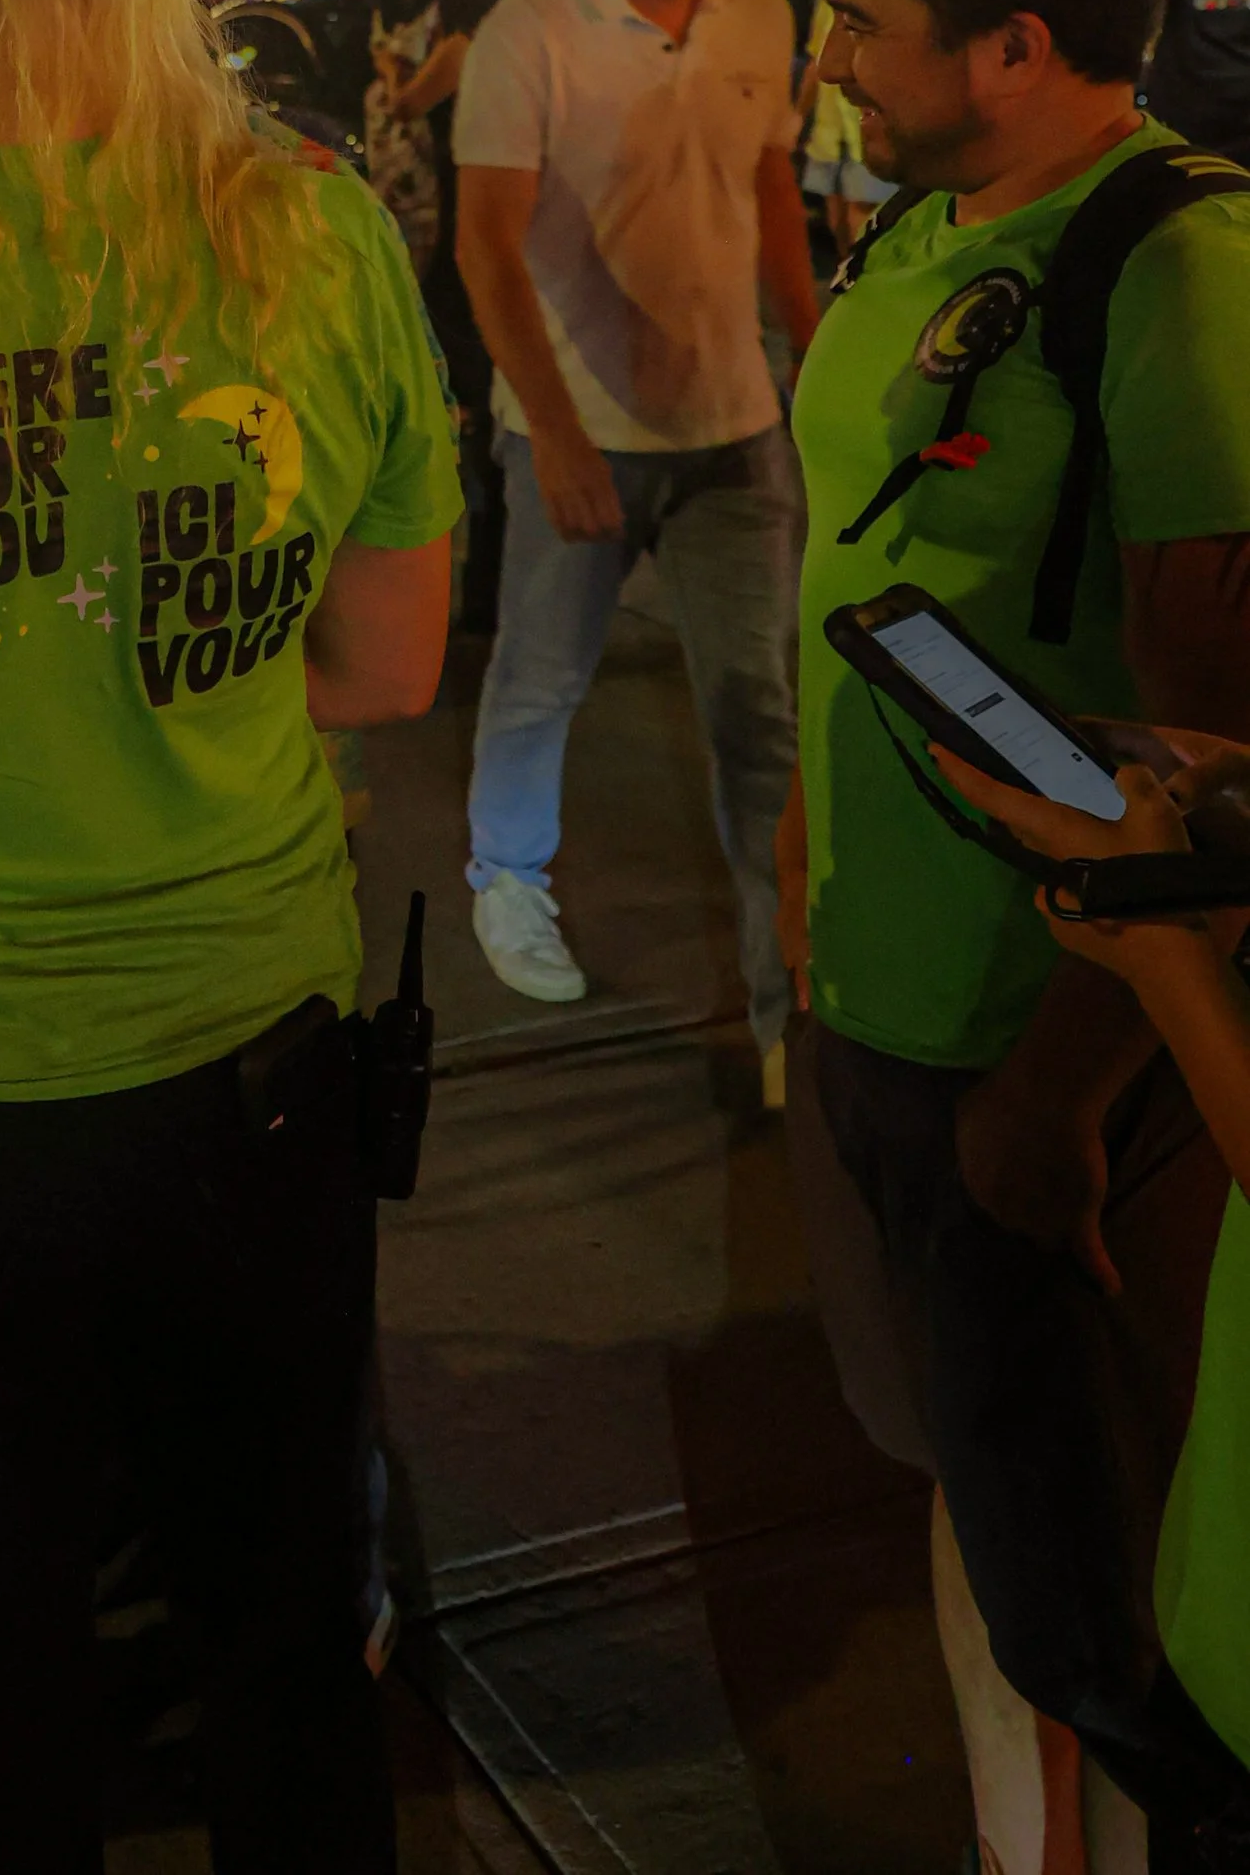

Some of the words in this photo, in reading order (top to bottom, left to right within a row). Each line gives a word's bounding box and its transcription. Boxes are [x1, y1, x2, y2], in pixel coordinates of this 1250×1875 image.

[137, 481, 237, 565] ICI
[138, 531, 316, 638] POUR
[137, 600, 306, 709] VOUS
